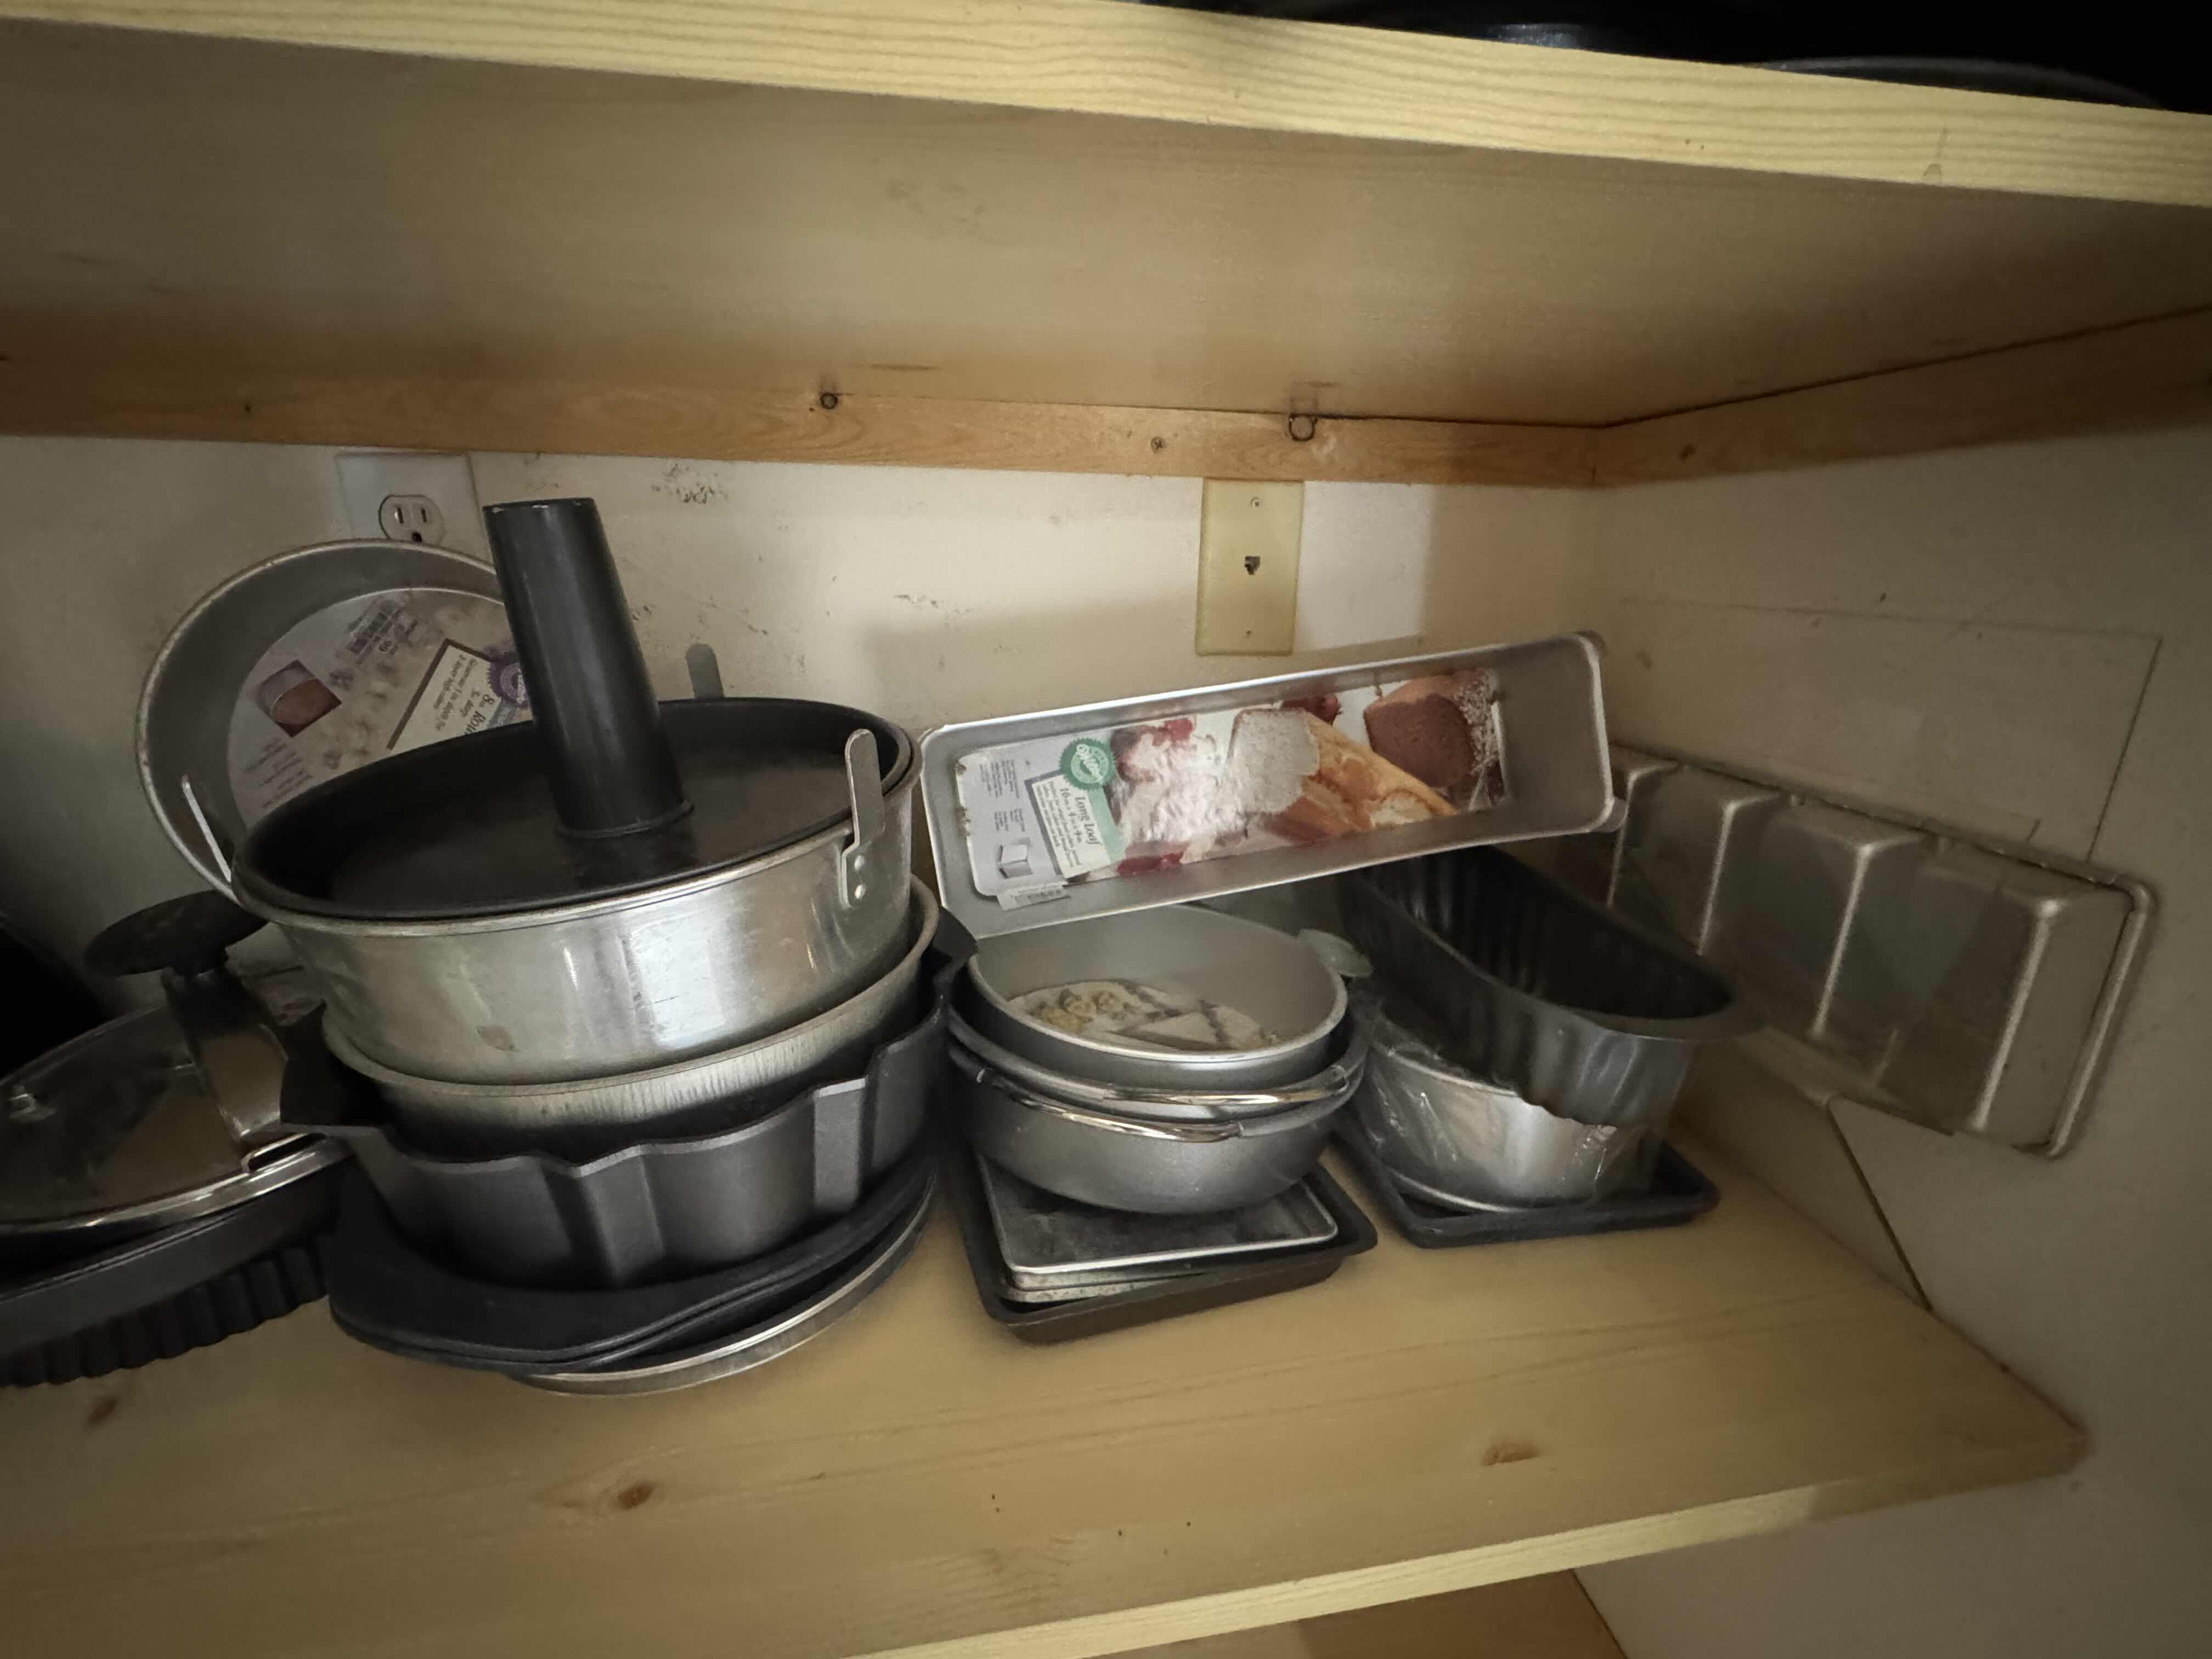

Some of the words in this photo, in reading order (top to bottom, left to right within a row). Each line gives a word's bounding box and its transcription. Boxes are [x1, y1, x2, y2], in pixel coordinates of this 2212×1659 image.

[483, 694, 494, 704] 8
[465, 711, 486, 735] Rou
[1060, 788, 1071, 798] 16
[1075, 797, 1090, 821] Long
[1084, 823, 1101, 844] Loaf
